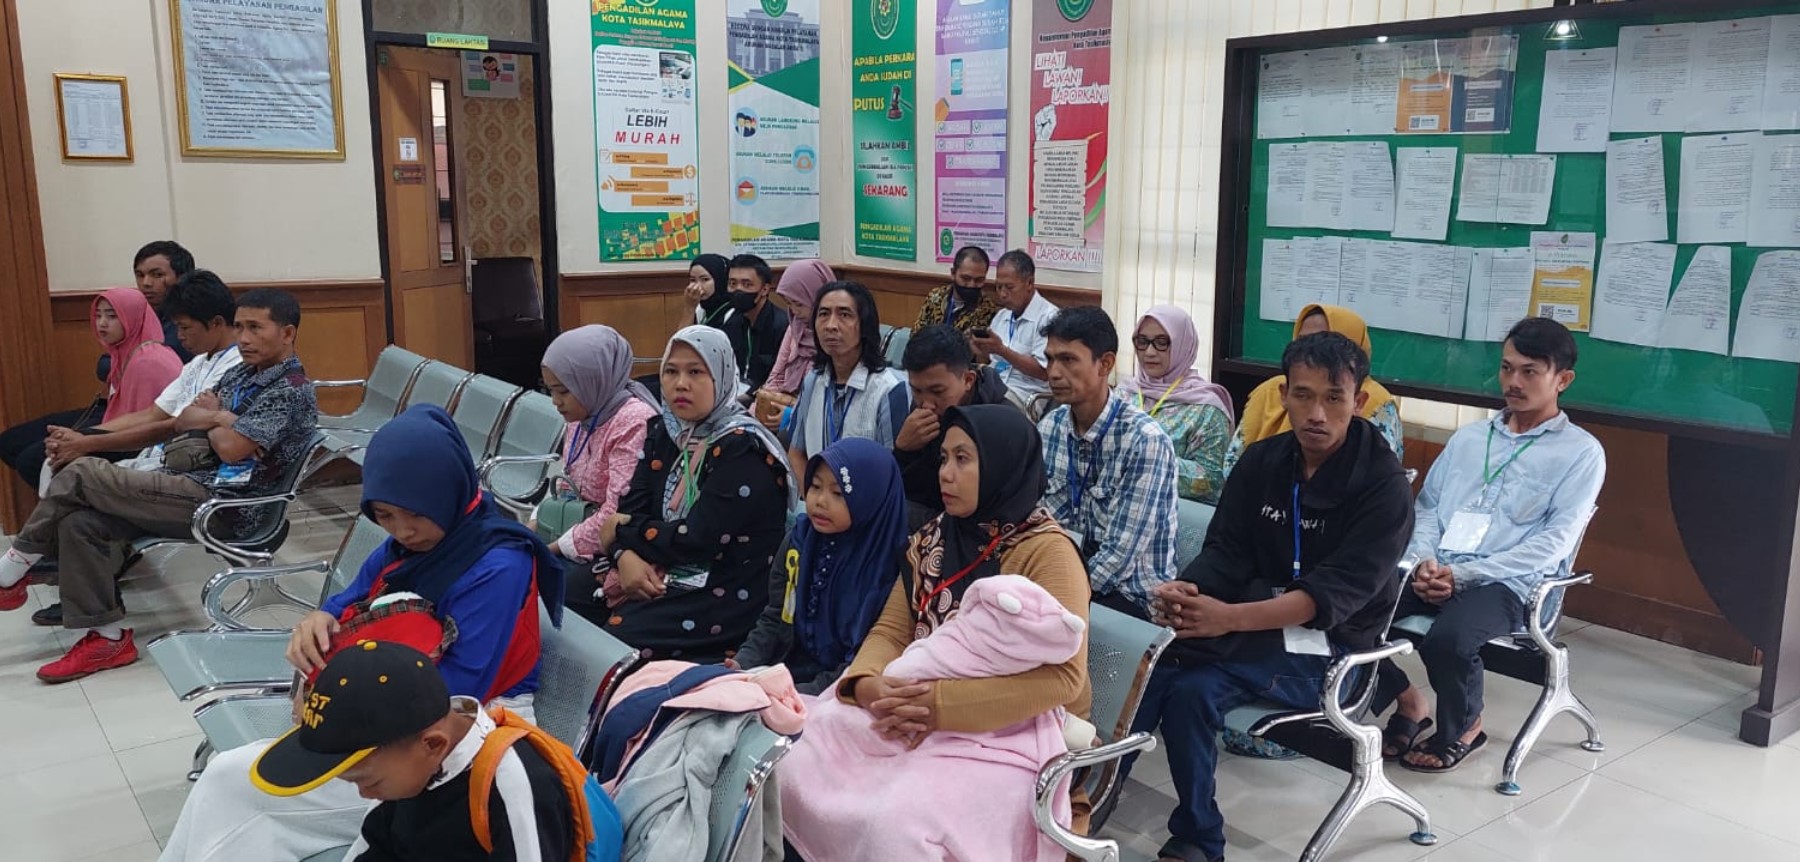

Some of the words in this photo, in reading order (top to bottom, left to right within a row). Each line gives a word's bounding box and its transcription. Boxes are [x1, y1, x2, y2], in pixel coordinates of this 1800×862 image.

[599, 3, 655, 15] PENGADILAN
[657, 9, 688, 18] AGAMA
[602, 14, 625, 24] KOTA
[627, 17, 685, 29] TASIKMALAYA
[854, 97, 884, 111] PUTUS
[627, 114, 668, 127] LEBIH
[615, 131, 680, 145] MURAH
[863, 184, 908, 197] SEKARANG
[1036, 247, 1086, 262] LAPORKAN
